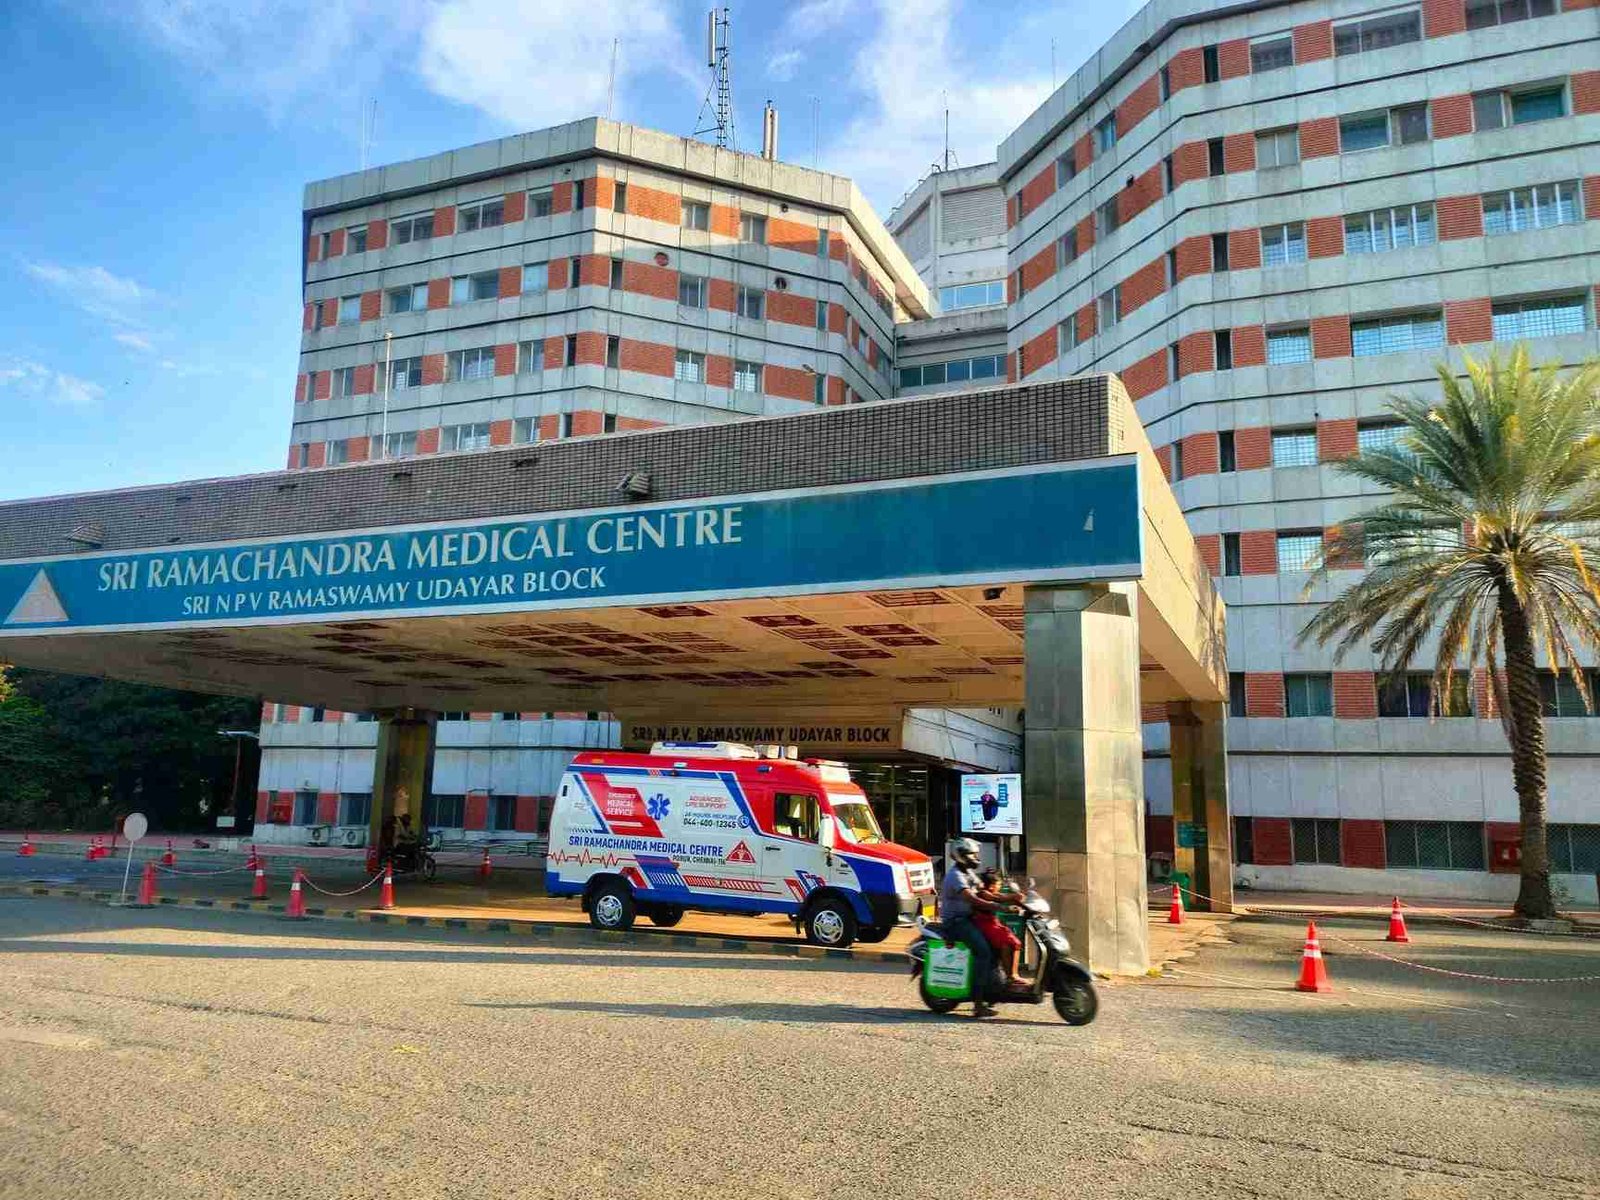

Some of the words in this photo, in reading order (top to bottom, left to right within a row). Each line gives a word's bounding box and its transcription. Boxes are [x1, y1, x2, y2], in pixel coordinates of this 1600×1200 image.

[98, 562, 138, 592] SRI
[147, 540, 396, 588] RAMACHANDRA
[407, 524, 574, 569] MEDICAL
[587, 506, 743, 554] CENTRE
[182, 594, 209, 616] SRI
[216, 594, 230, 614] N
[234, 593, 246, 612] P
[248, 592, 262, 612] V
[268, 581, 410, 611] RAMASWAMY
[417, 573, 516, 601] UDAYAR
[523, 567, 607, 593] BLOCK
[697, 727, 785, 742] RAMASWAMY
[789, 727, 842, 742] UDAYAR
[847, 727, 890, 742] BLOCK
[569, 835, 582, 846] SRI
[584, 836, 648, 852] RAMACHANDRA
[649, 841, 687, 855] MEDICAL
[689, 844, 724, 857] CENTRE
